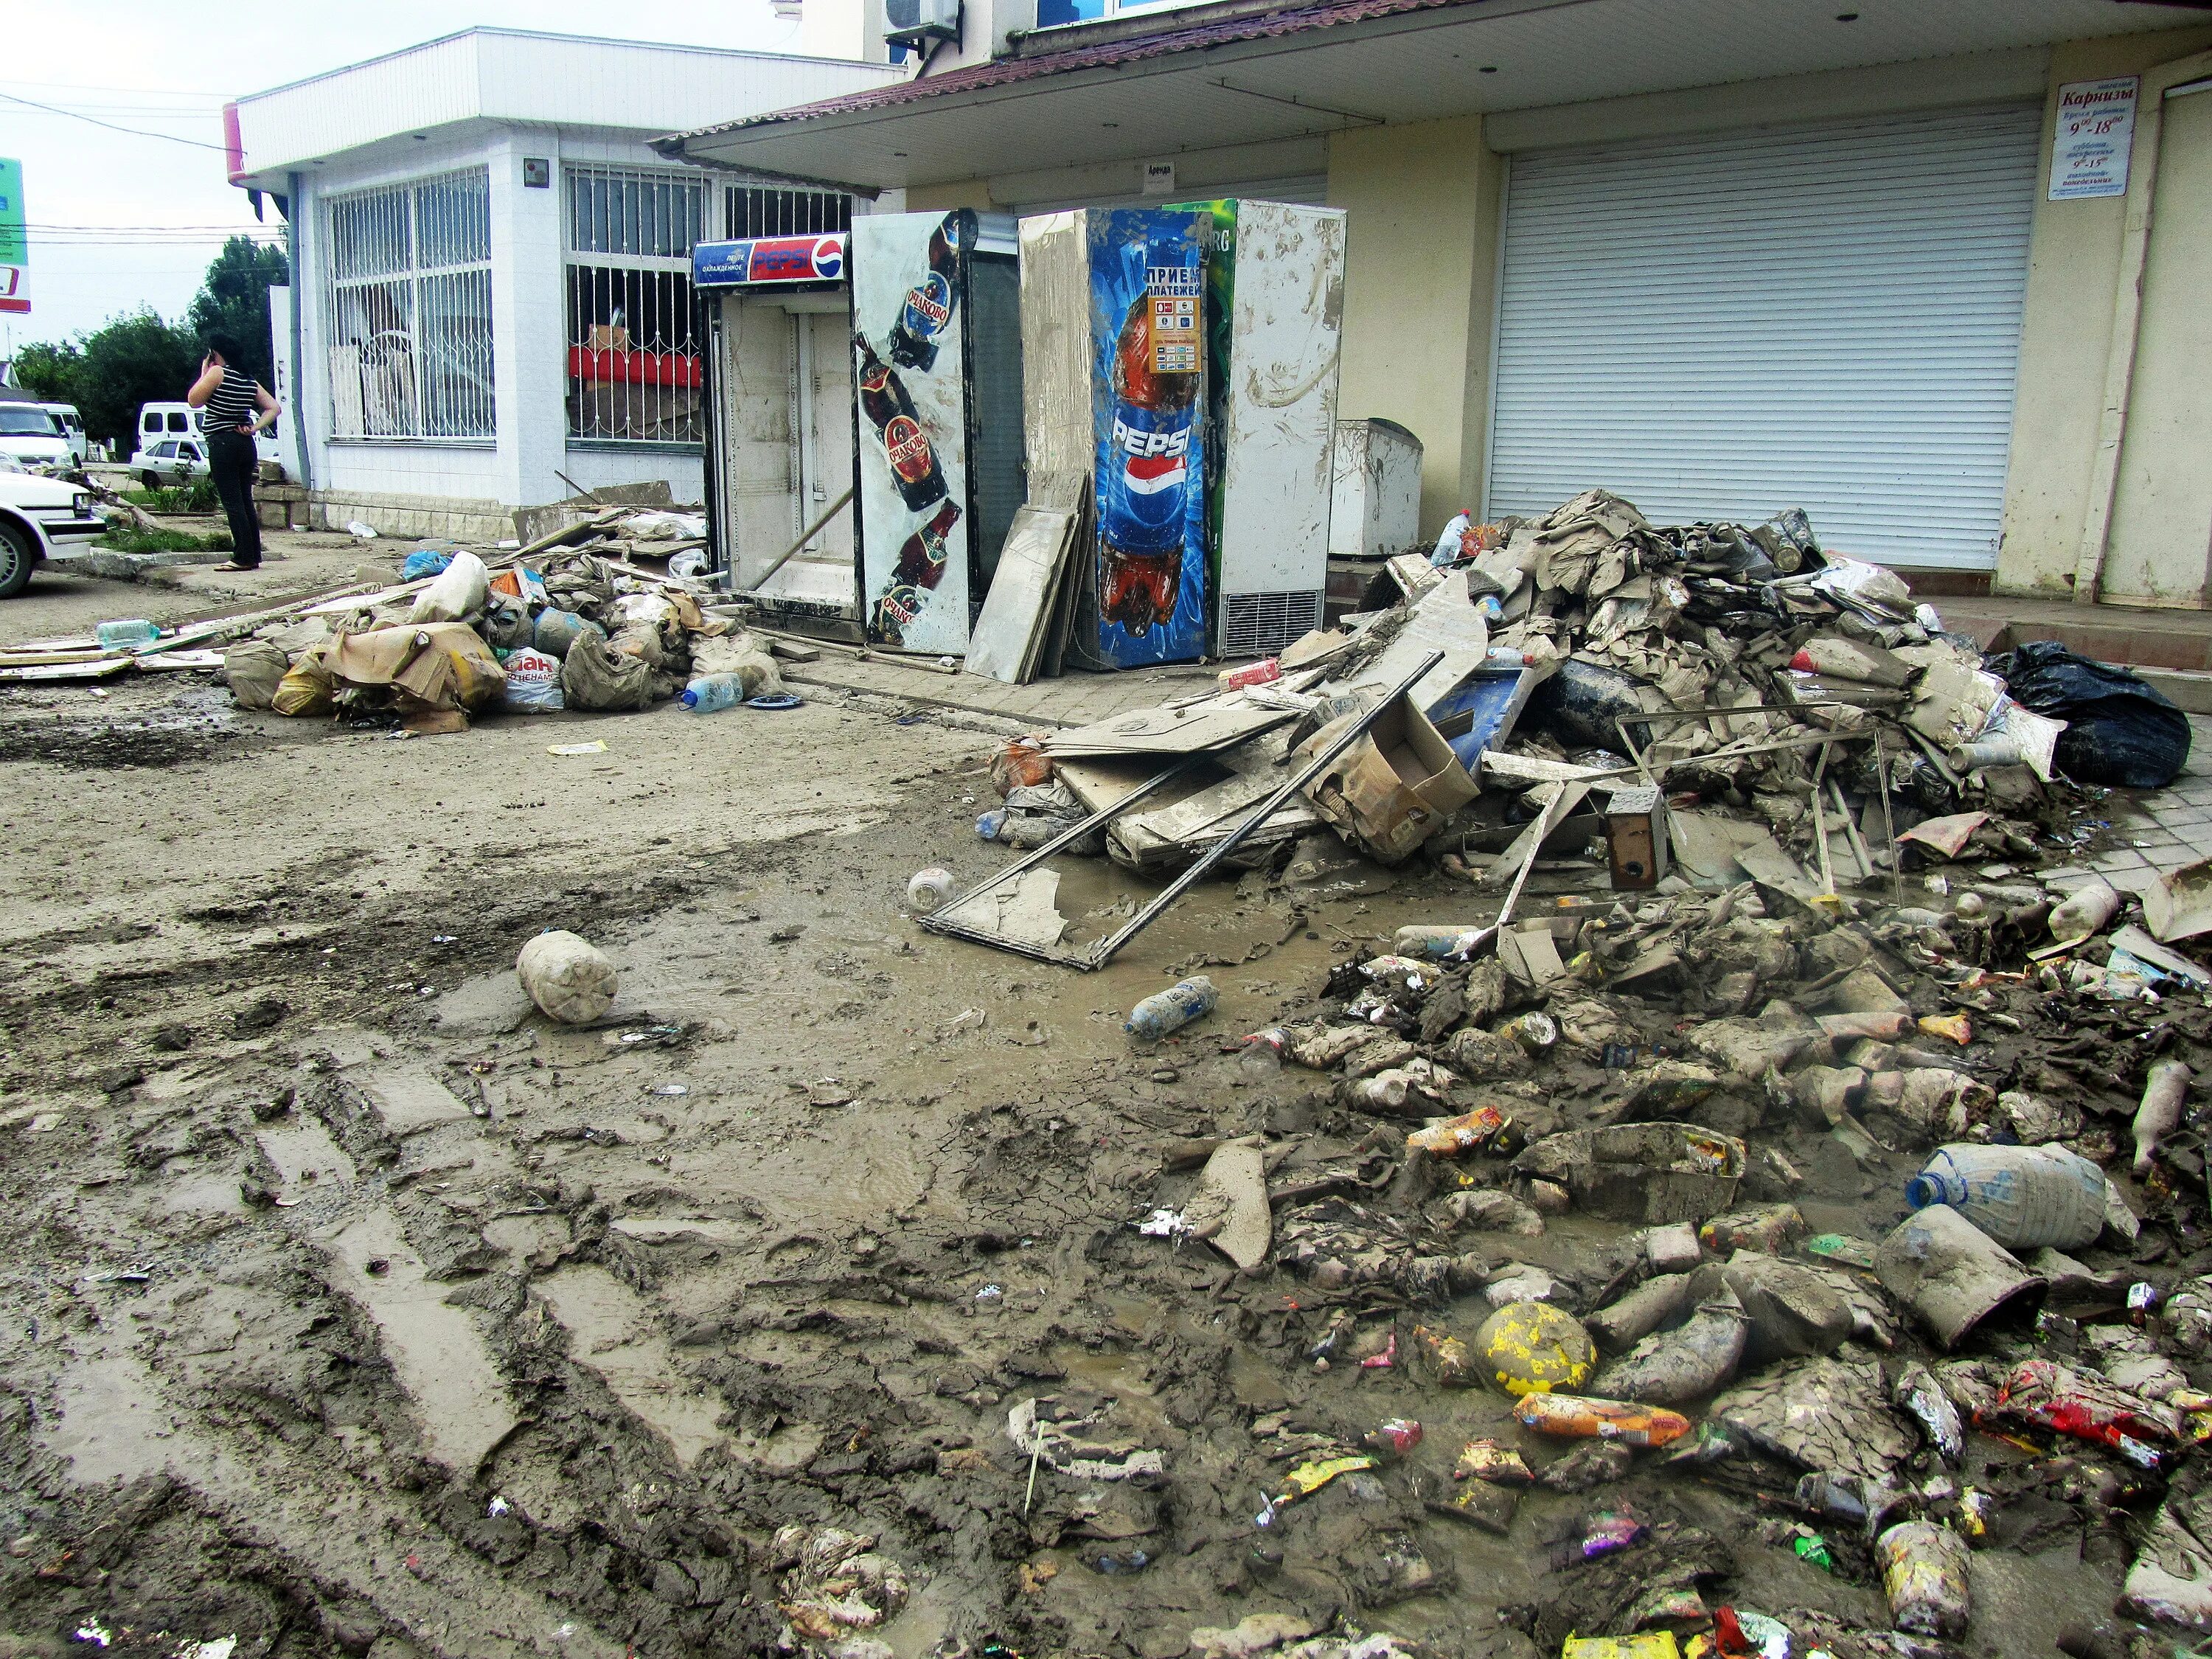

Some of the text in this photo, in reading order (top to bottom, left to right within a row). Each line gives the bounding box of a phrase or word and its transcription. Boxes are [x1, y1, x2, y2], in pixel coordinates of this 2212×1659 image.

[2062, 89, 2133, 108] Карнизы
[702, 264, 742, 273] ОХЛАЖДЕННОЕ
[753, 248, 810, 272] PEPSI
[1147, 284, 1200, 296] ПЛАТЕЖЕЙ
[908, 290, 947, 321] ОЧАКОВО
[889, 434, 926, 462] ОЧАКОВО
[1112, 416, 1191, 458] PEPSI
[885, 597, 915, 624] ОЧАКО
